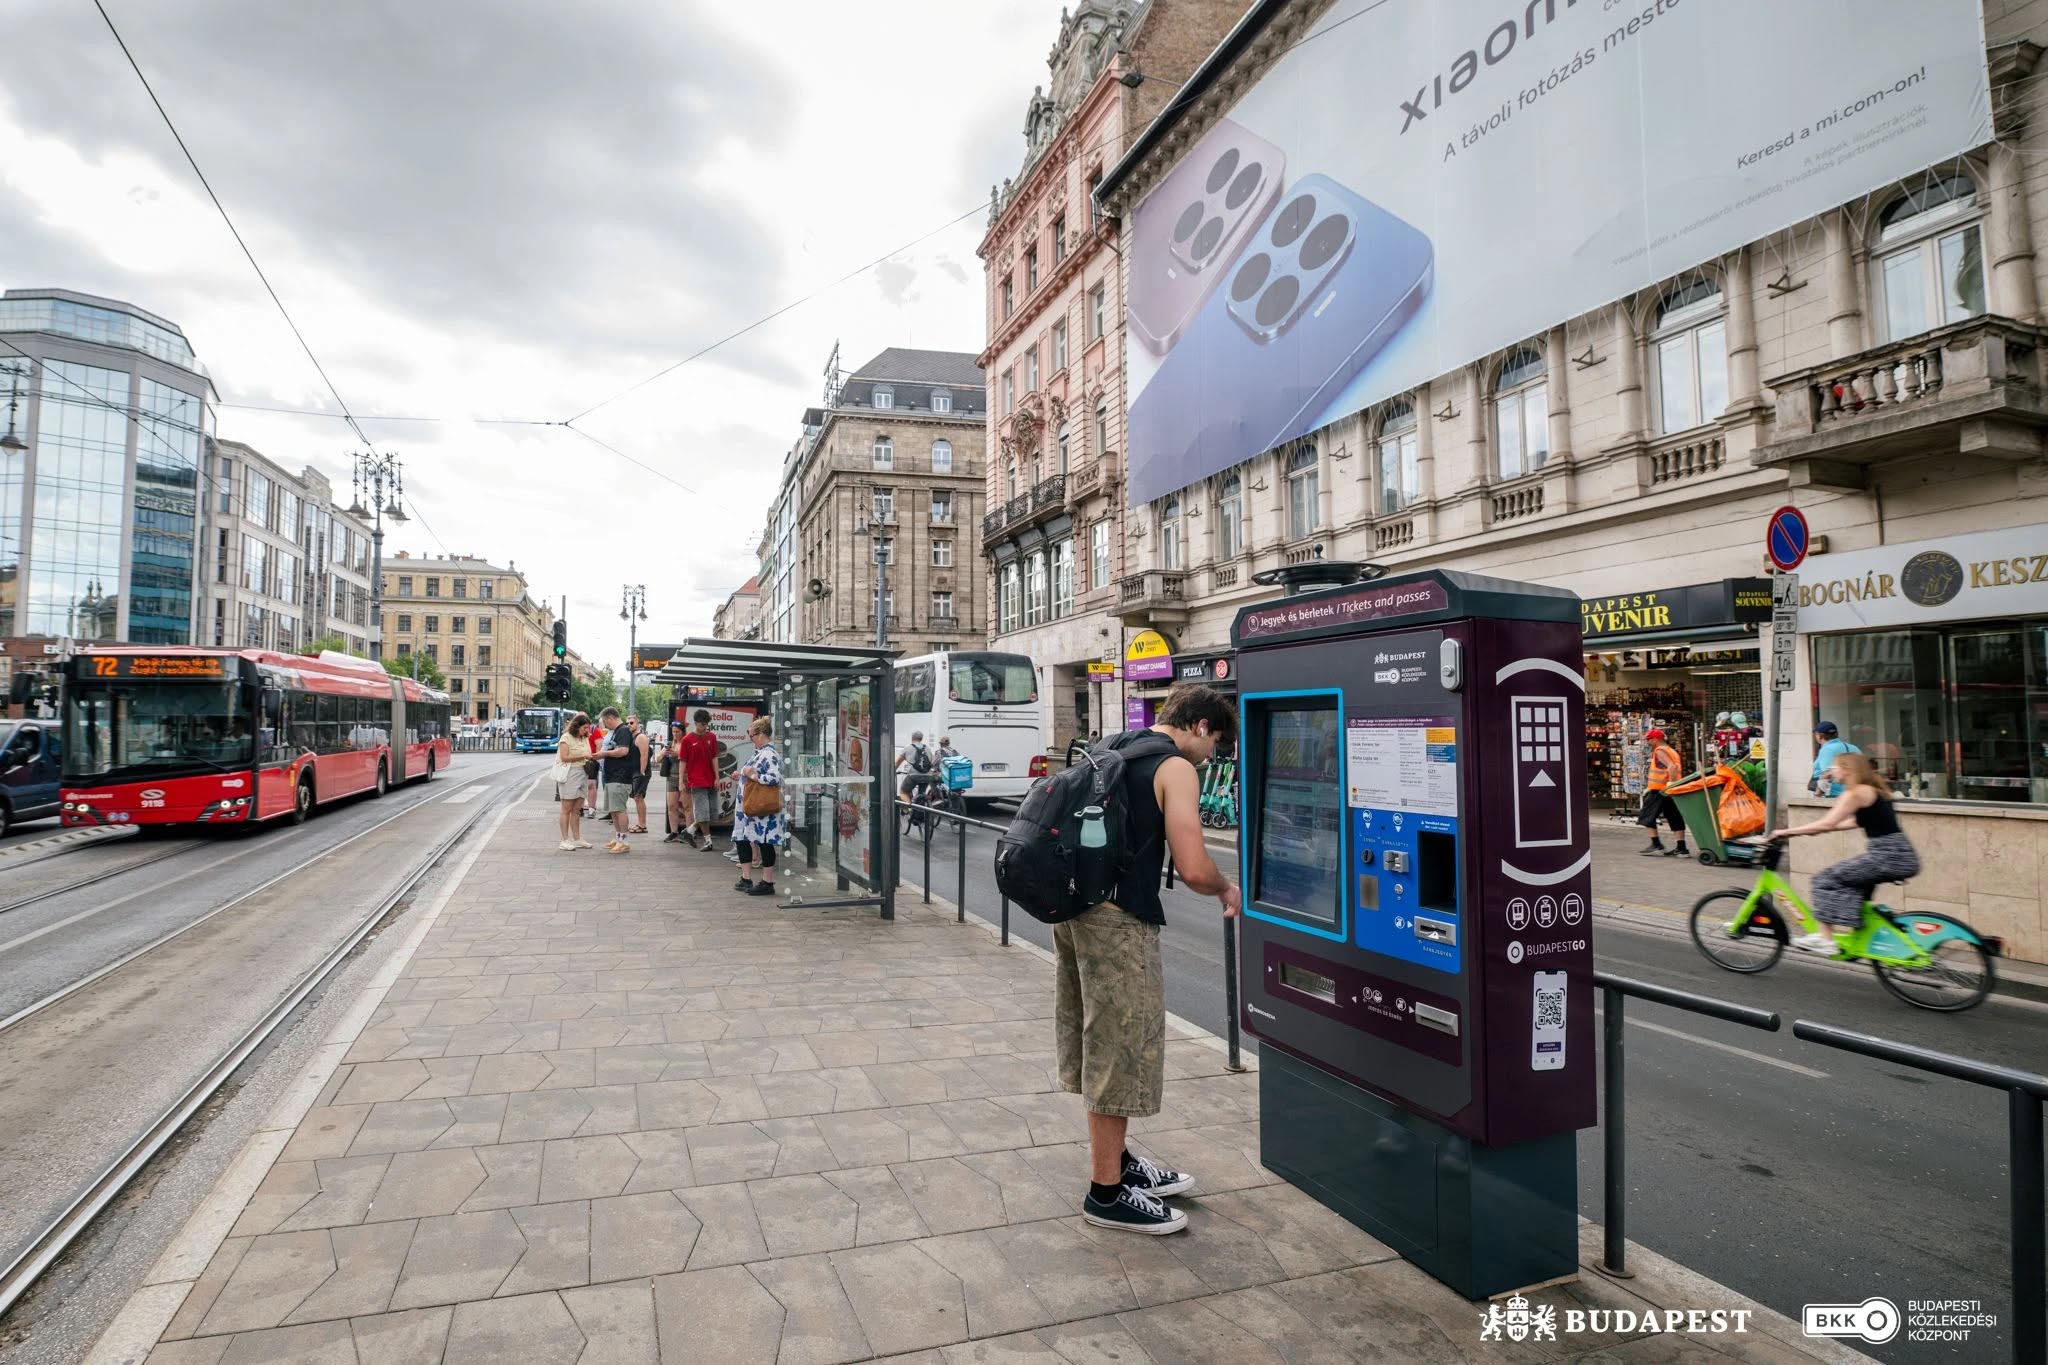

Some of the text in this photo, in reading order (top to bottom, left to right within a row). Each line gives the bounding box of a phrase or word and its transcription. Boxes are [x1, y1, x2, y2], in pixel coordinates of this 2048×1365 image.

[1444, 142, 1456, 162] A
[1462, 101, 1511, 148] távoli
[1518, 47, 1596, 110] fotózás
[1737, 66, 1926, 169] Keresd a mi.com-on!
[1968, 555, 2048, 588] KESZ
[1799, 570, 1896, 608] BOGNÁR
[1260, 614, 1286, 627] Jegyek
[1288, 611, 1297, 621] és
[1299, 606, 1334, 620] bérletek
[1342, 600, 1373, 613] Tickets
[1374, 597, 1394, 608] and
[1396, 590, 1431, 605] passes
[1582, 594, 1656, 614] DAPEST
[1735, 597, 1772, 606] SOUVENIR
[1778, 637, 1791, 648] 5 m
[1390, 652, 1426, 661] BUDAPEST
[92, 657, 118, 676] 72
[1183, 667, 1202, 677] PIZZA
[710, 712, 733, 721] tella
[141, 800, 165, 808] 9118
[1526, 939, 1586, 956] BUDAPESTGO
